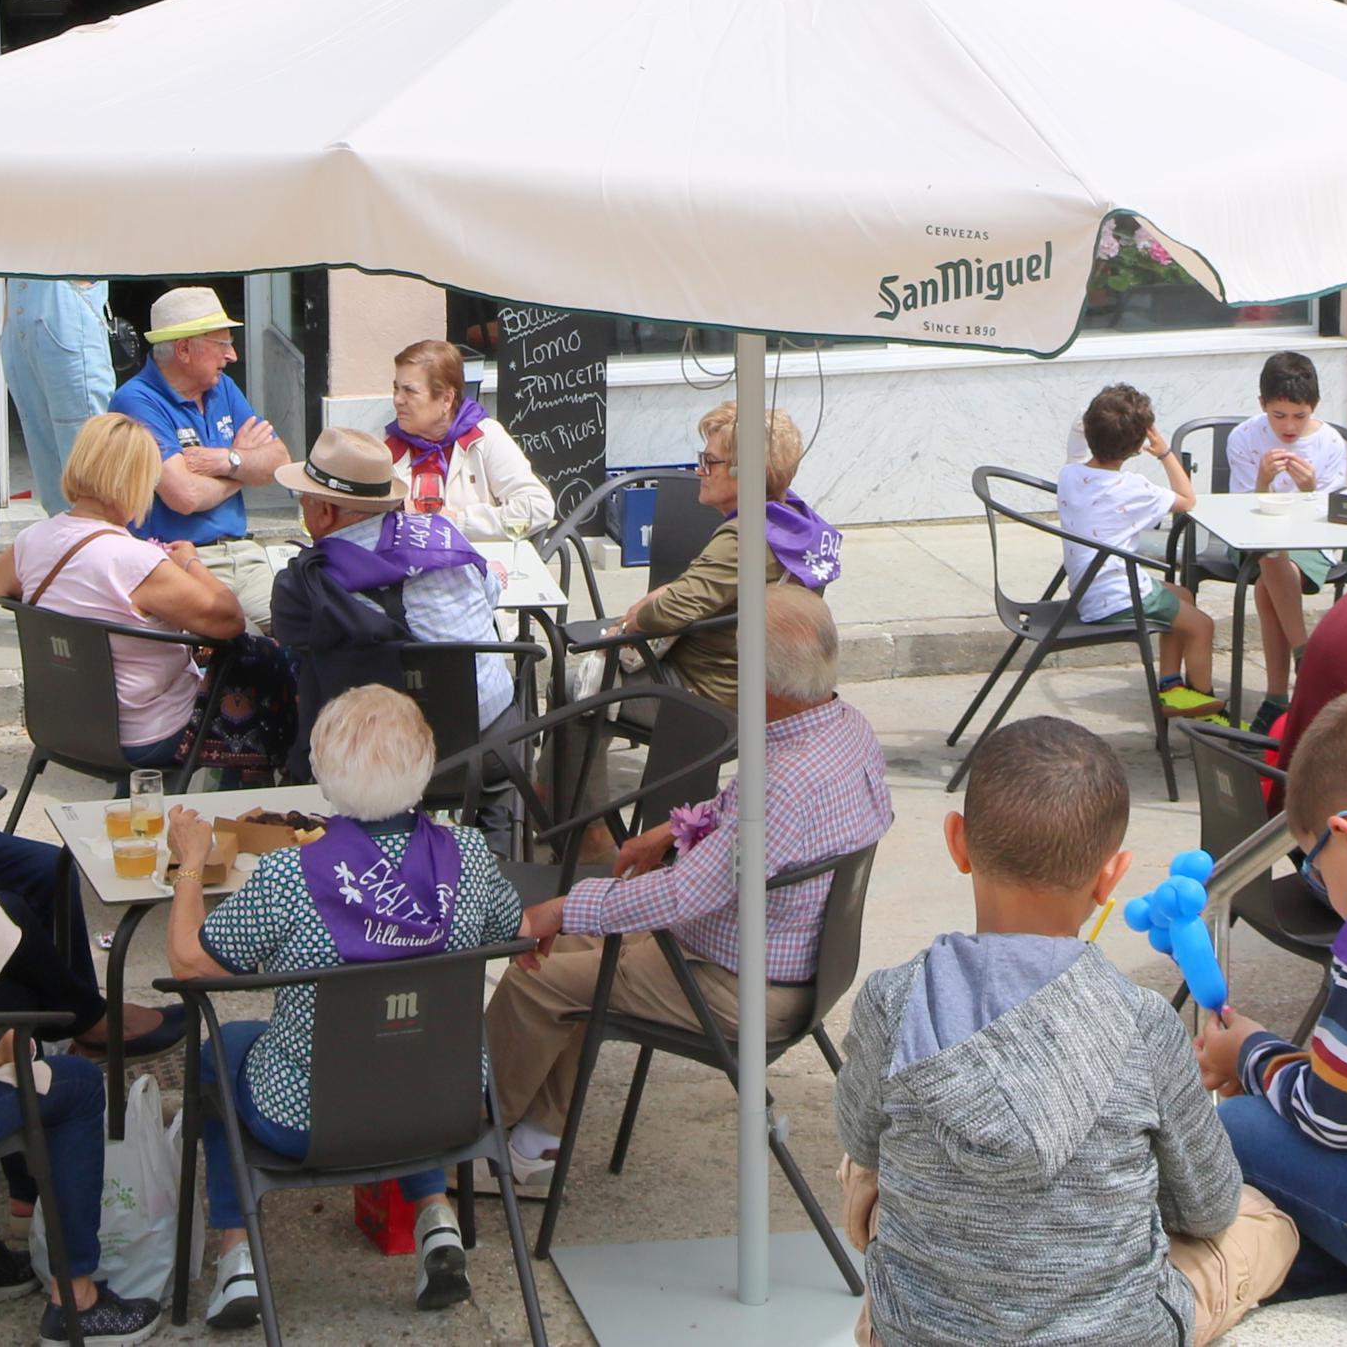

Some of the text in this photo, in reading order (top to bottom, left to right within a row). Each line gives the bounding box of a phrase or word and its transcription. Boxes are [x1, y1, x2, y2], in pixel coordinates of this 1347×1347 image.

[925, 225, 990, 241] CERVEZAS
[923, 321, 997, 338] SINCE 1890
